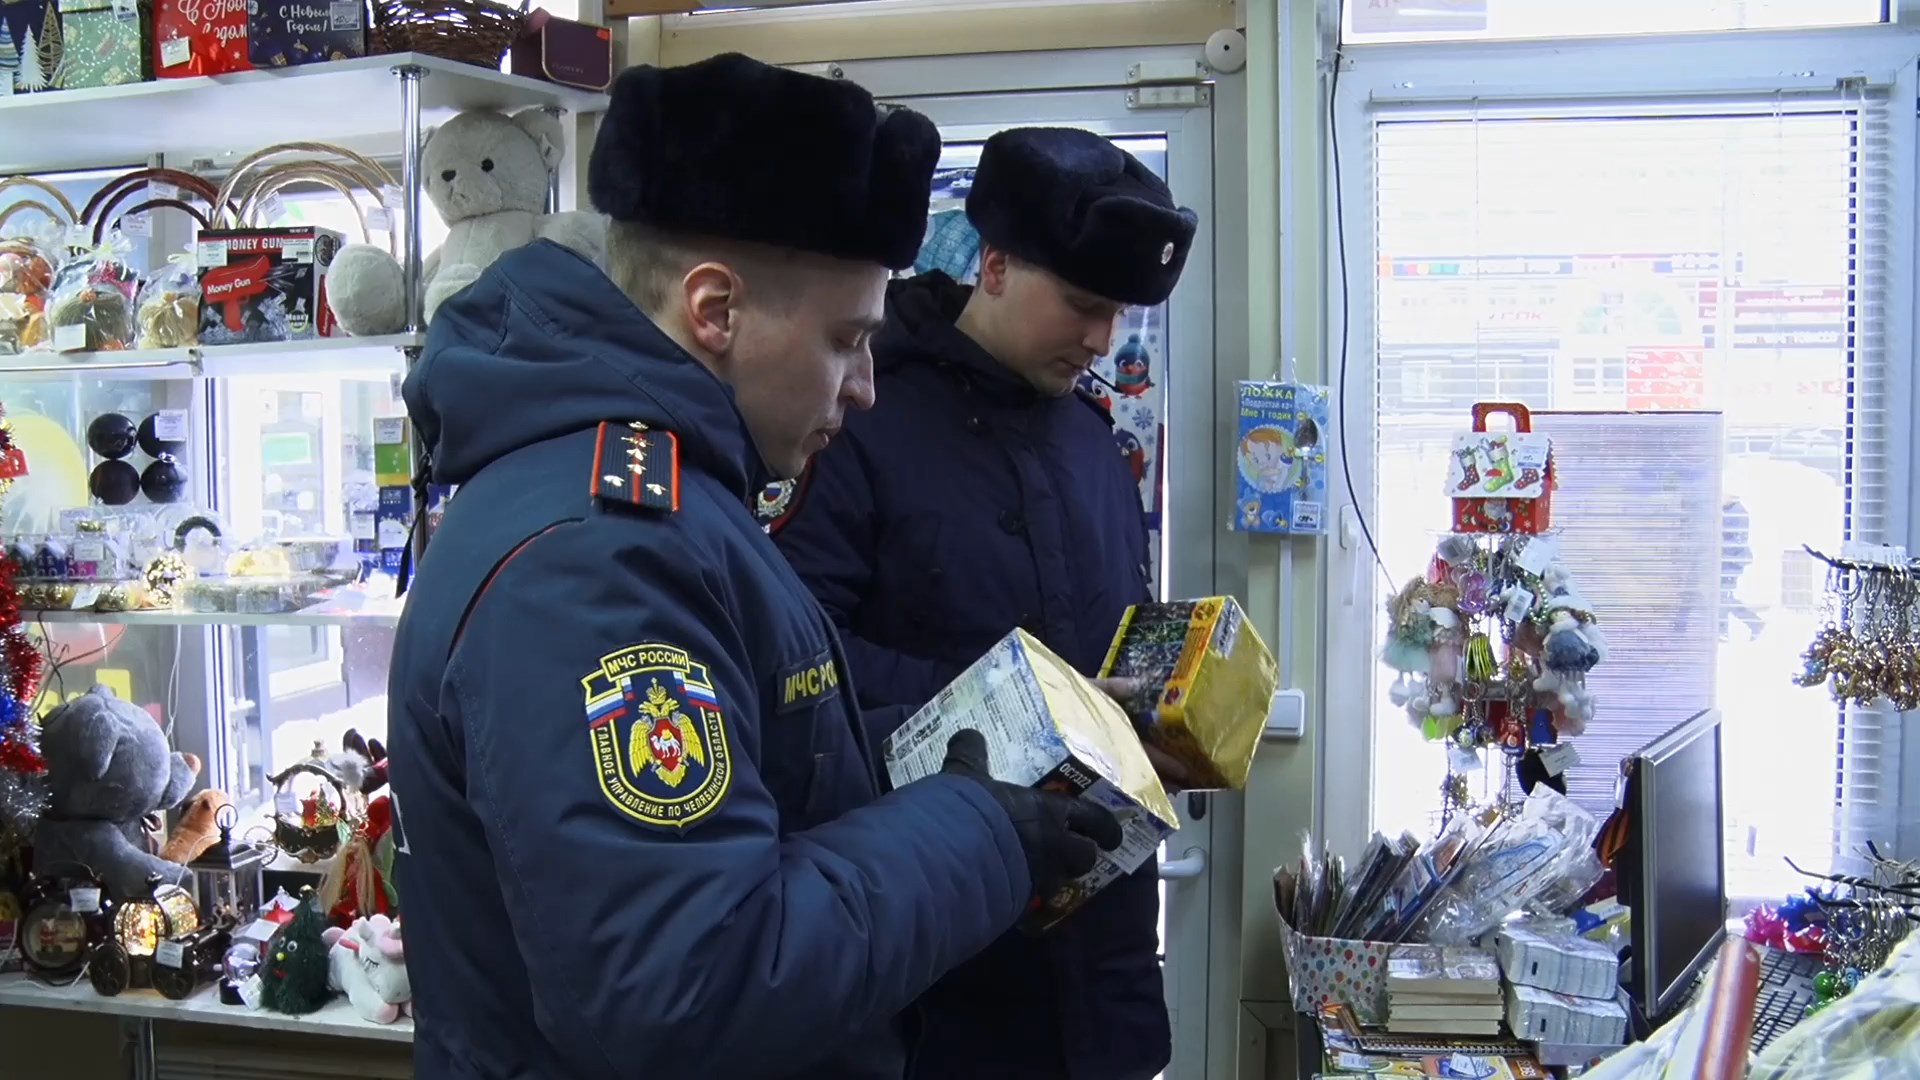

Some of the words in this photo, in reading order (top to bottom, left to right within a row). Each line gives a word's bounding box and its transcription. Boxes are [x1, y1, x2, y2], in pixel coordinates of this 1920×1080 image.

[279, 5, 288, 18] С
[207, 282, 232, 295] Money
[234, 278, 251, 288] Gun
[1241, 386, 1293, 400] ЛОЖКА
[607, 654, 637, 674] МЧС
[639, 650, 687, 667] РОССИИ
[784, 667, 820, 704] МЧС
[596, 726, 616, 776] ГЛАВНОЕ
[607, 776, 664, 817] УПРАВЛЕНИЕ
[667, 805, 681, 817] ПО
[684, 760, 726, 813] ЧЕЛЯБИНСКОЙ
[707, 711, 725, 758] ОБЛАСТИ
